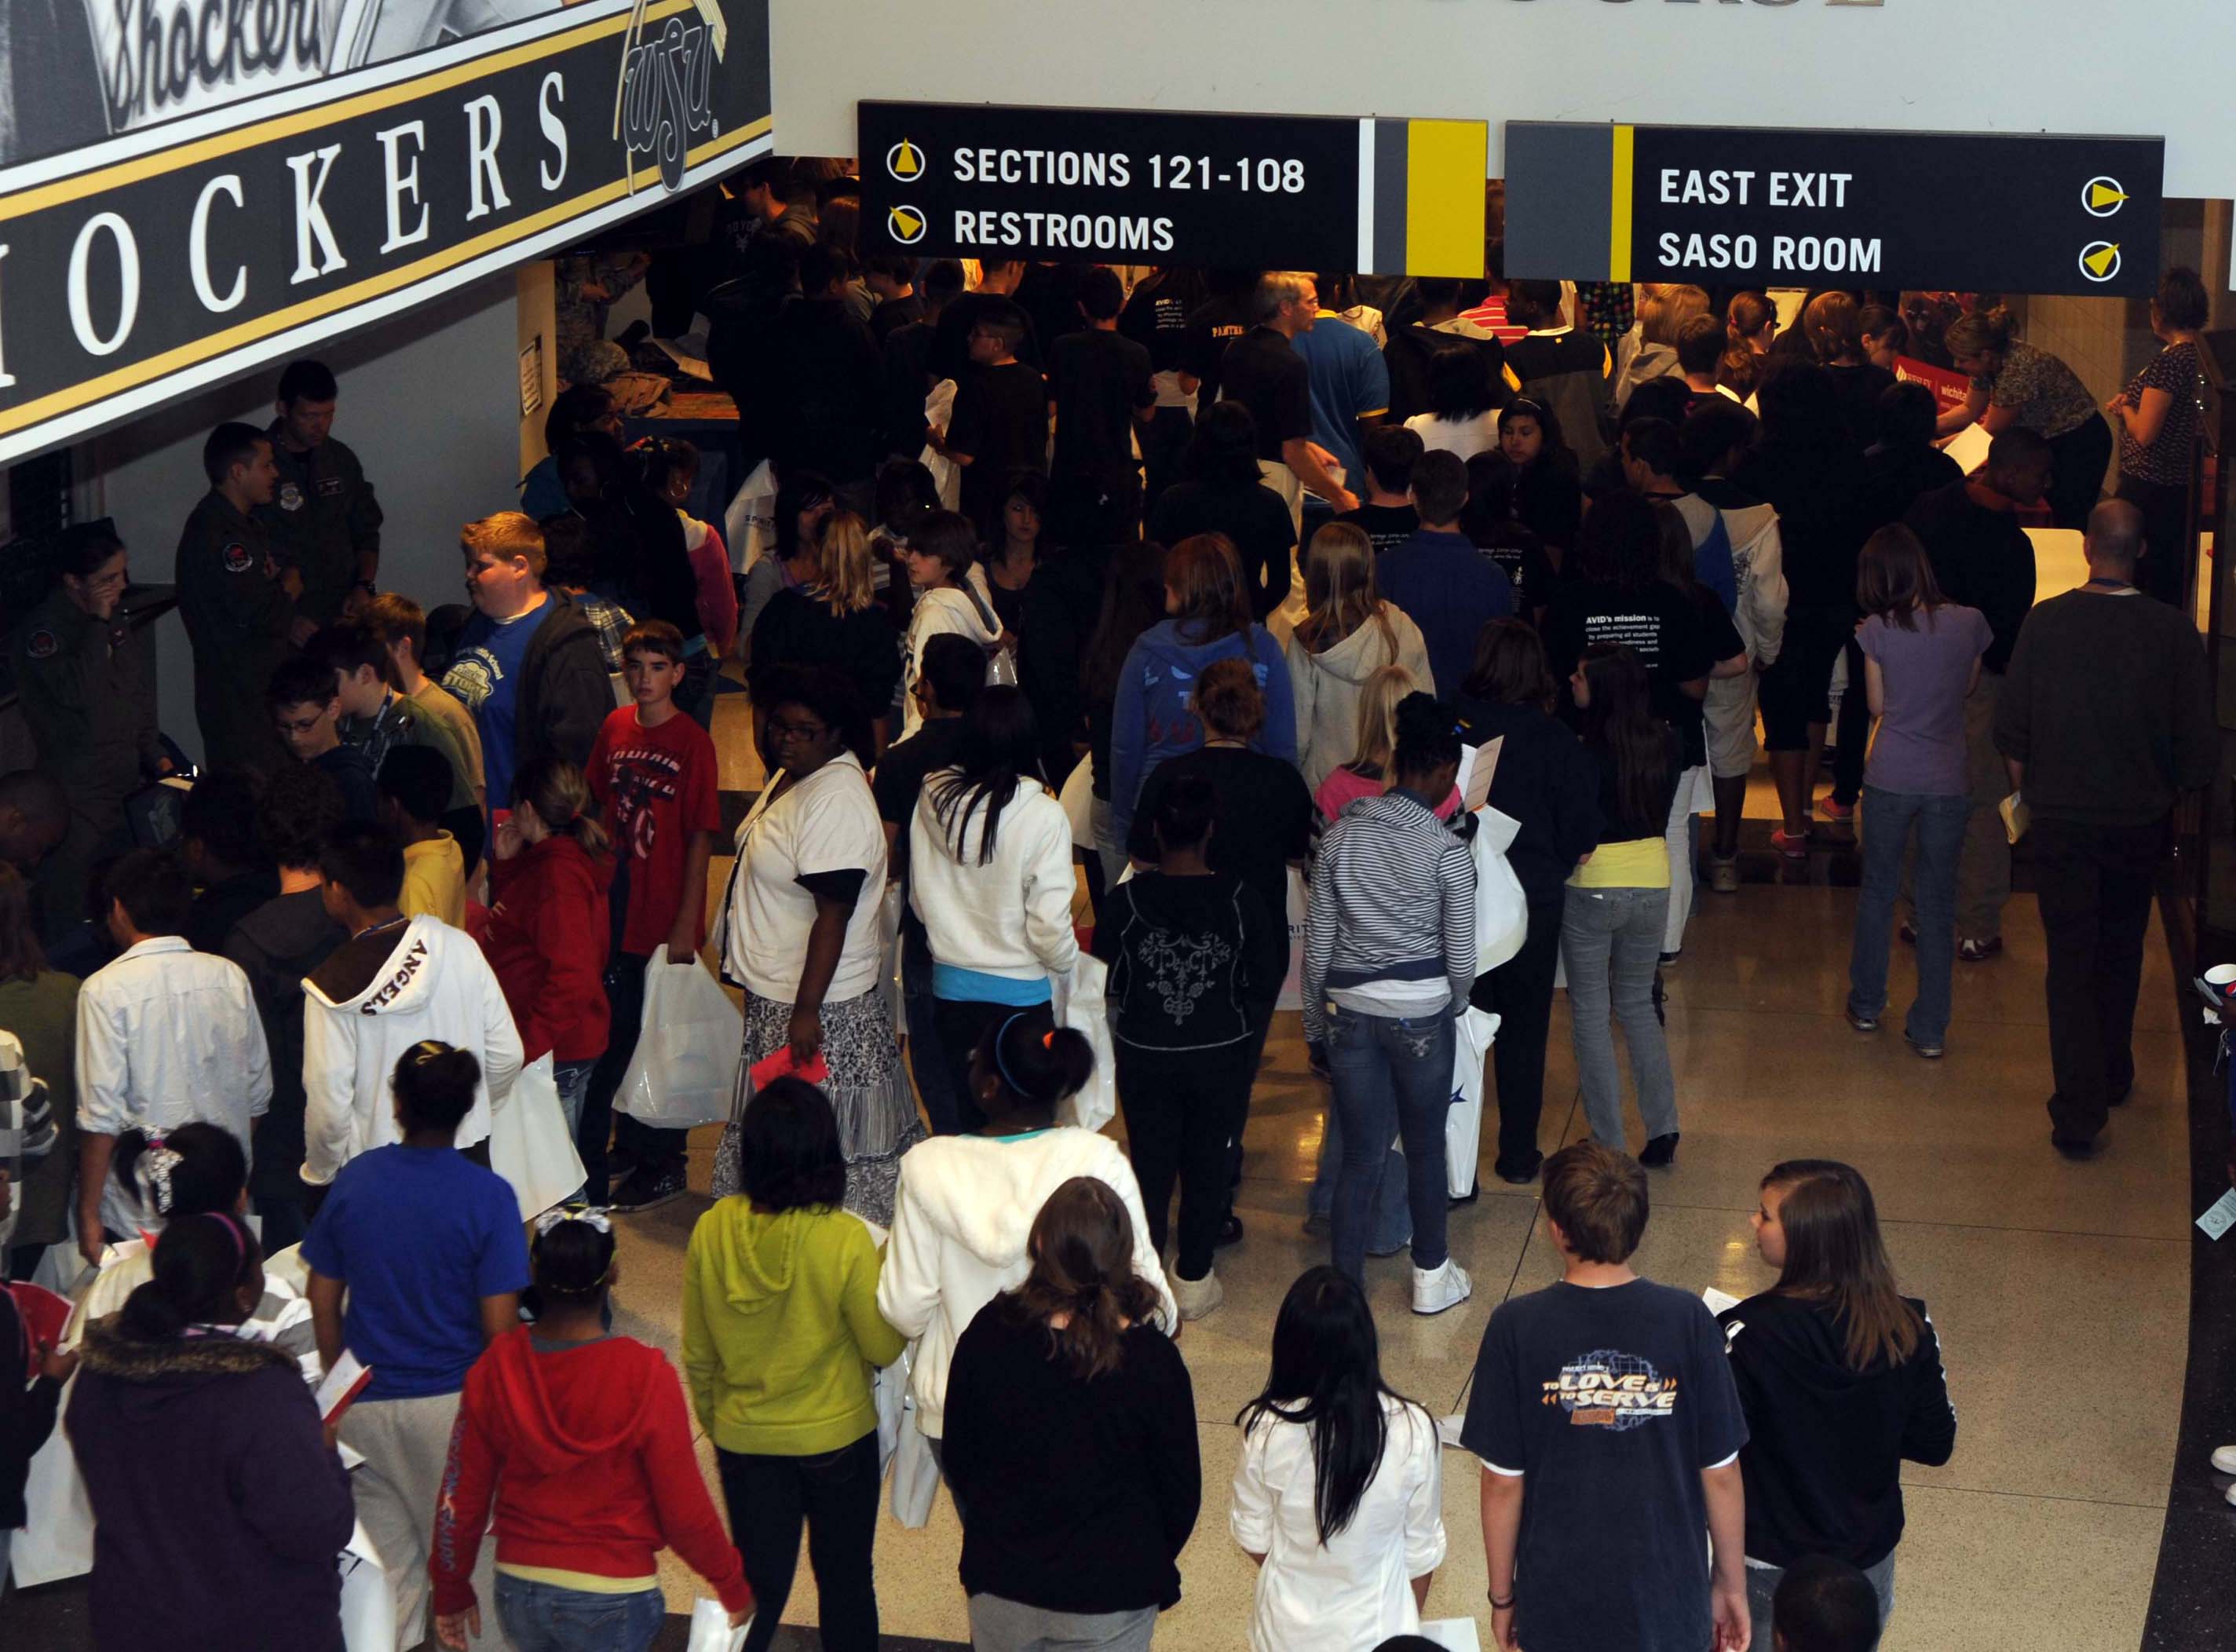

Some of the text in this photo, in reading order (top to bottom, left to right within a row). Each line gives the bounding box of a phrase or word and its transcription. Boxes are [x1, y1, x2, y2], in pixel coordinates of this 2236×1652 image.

[953, 148, 1306, 193] SECTIONS 121-108
[1660, 169, 1853, 208] EAST EXIT
[954, 210, 1175, 251] RESTROOMS
[1658, 232, 1881, 272] SASO ROOM
[1586, 615, 1612, 624] AVID's
[360, 939, 428, 1016] ANGELS
[1543, 1381, 1559, 1391] TO
[1559, 1374, 1647, 1391] LOVE
[1560, 1391, 1677, 1408] TO SERVE
